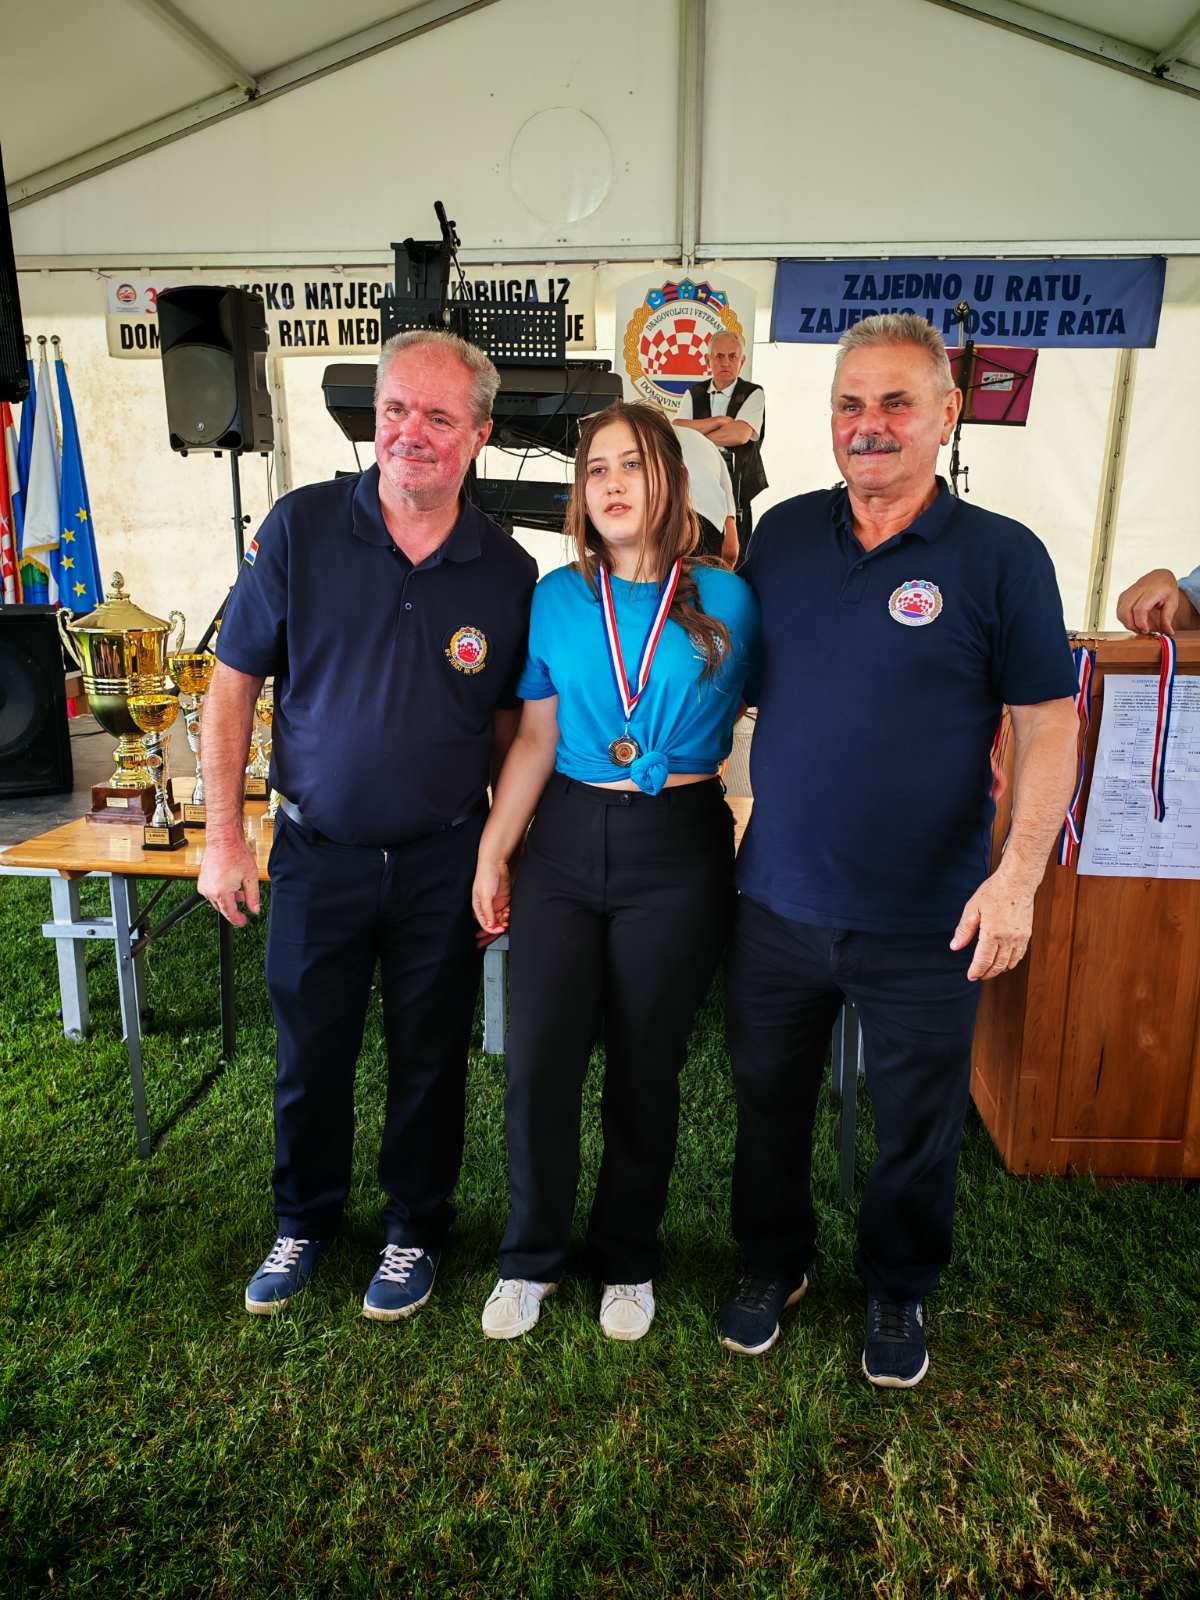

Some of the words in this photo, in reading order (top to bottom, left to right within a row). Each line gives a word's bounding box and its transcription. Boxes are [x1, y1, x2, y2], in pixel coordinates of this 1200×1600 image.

[304, 282, 397, 310] NATJECA
[842, 273, 962, 301] ZAJEDNO
[973, 274, 994, 302] U
[1005, 274, 1093, 305] RATU,
[279, 319, 330, 347] RATA
[942, 308, 1049, 337] POSLIJE
[1057, 308, 1126, 336] RATA
